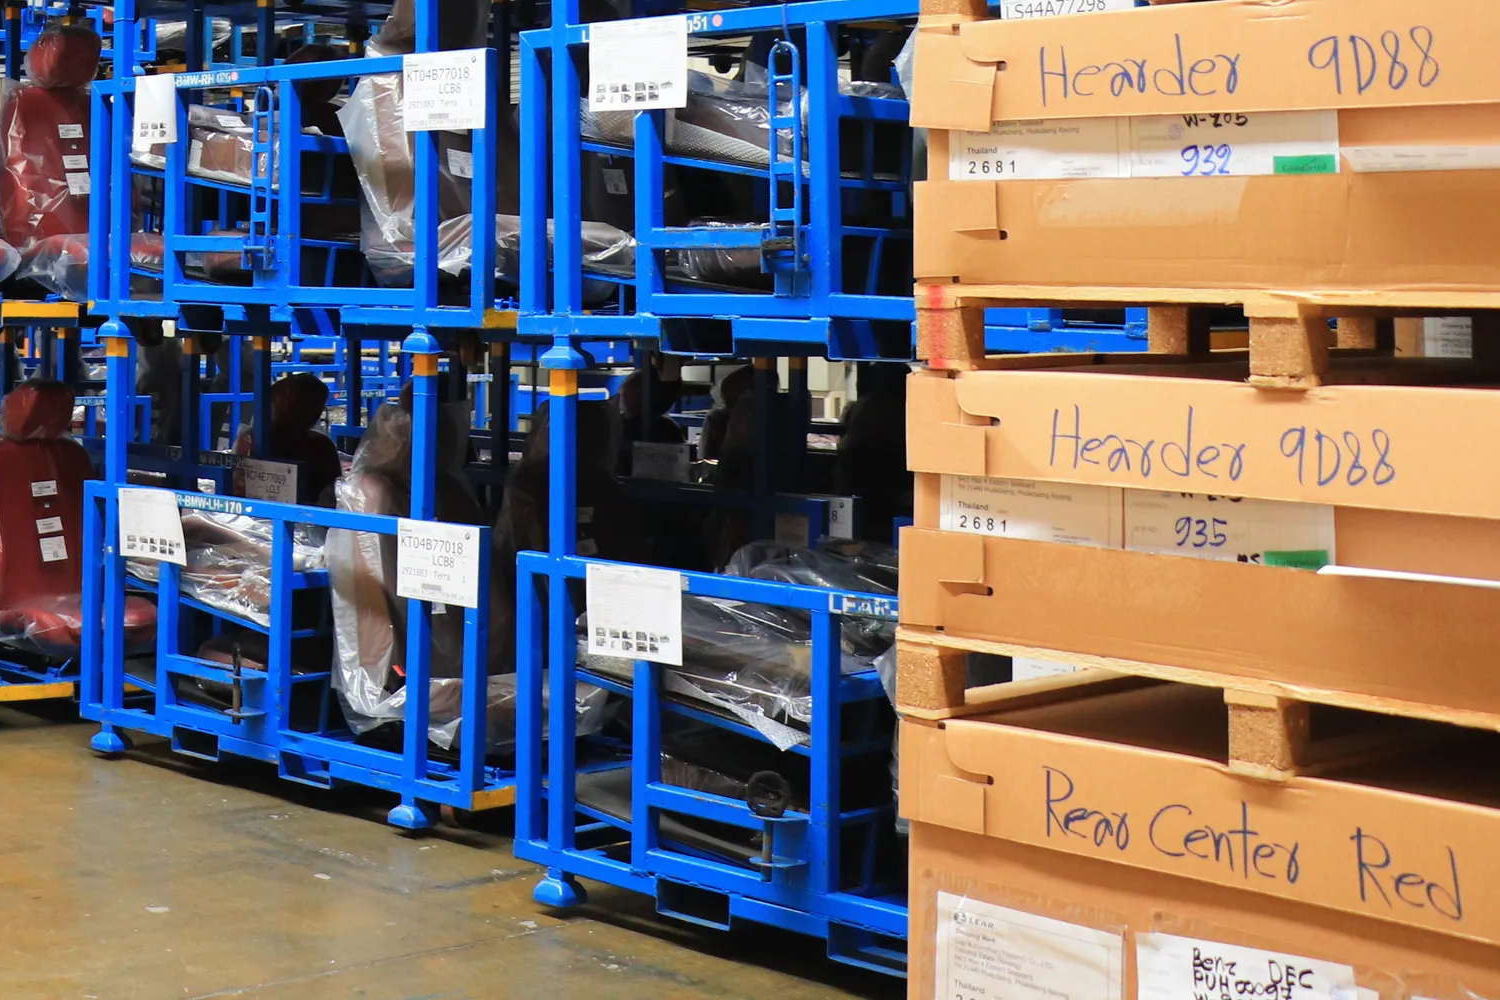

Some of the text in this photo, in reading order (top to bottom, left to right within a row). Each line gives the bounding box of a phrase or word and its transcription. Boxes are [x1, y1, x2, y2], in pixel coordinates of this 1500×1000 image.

[1308, 25, 1440, 96] 9D88
[406, 67, 470, 83] KT04B77018
[439, 83, 462, 95] LCB8
[1282, 162, 1327, 173] Completed
[1280, 426, 1395, 487] 9D88
[958, 501, 989, 511] Thailand
[1175, 516, 1228, 548] 935
[401, 535, 464, 555] KT04B77018
[433, 555, 456, 569] LCB8
[434, 571, 451, 581] Terra
[1149, 800, 1301, 884] Center
[1349, 826, 1463, 921] Red
[969, 917, 995, 929] LEAR
[1192, 947, 1314, 990] Benz DEC
[954, 979, 986, 995] Thailand
